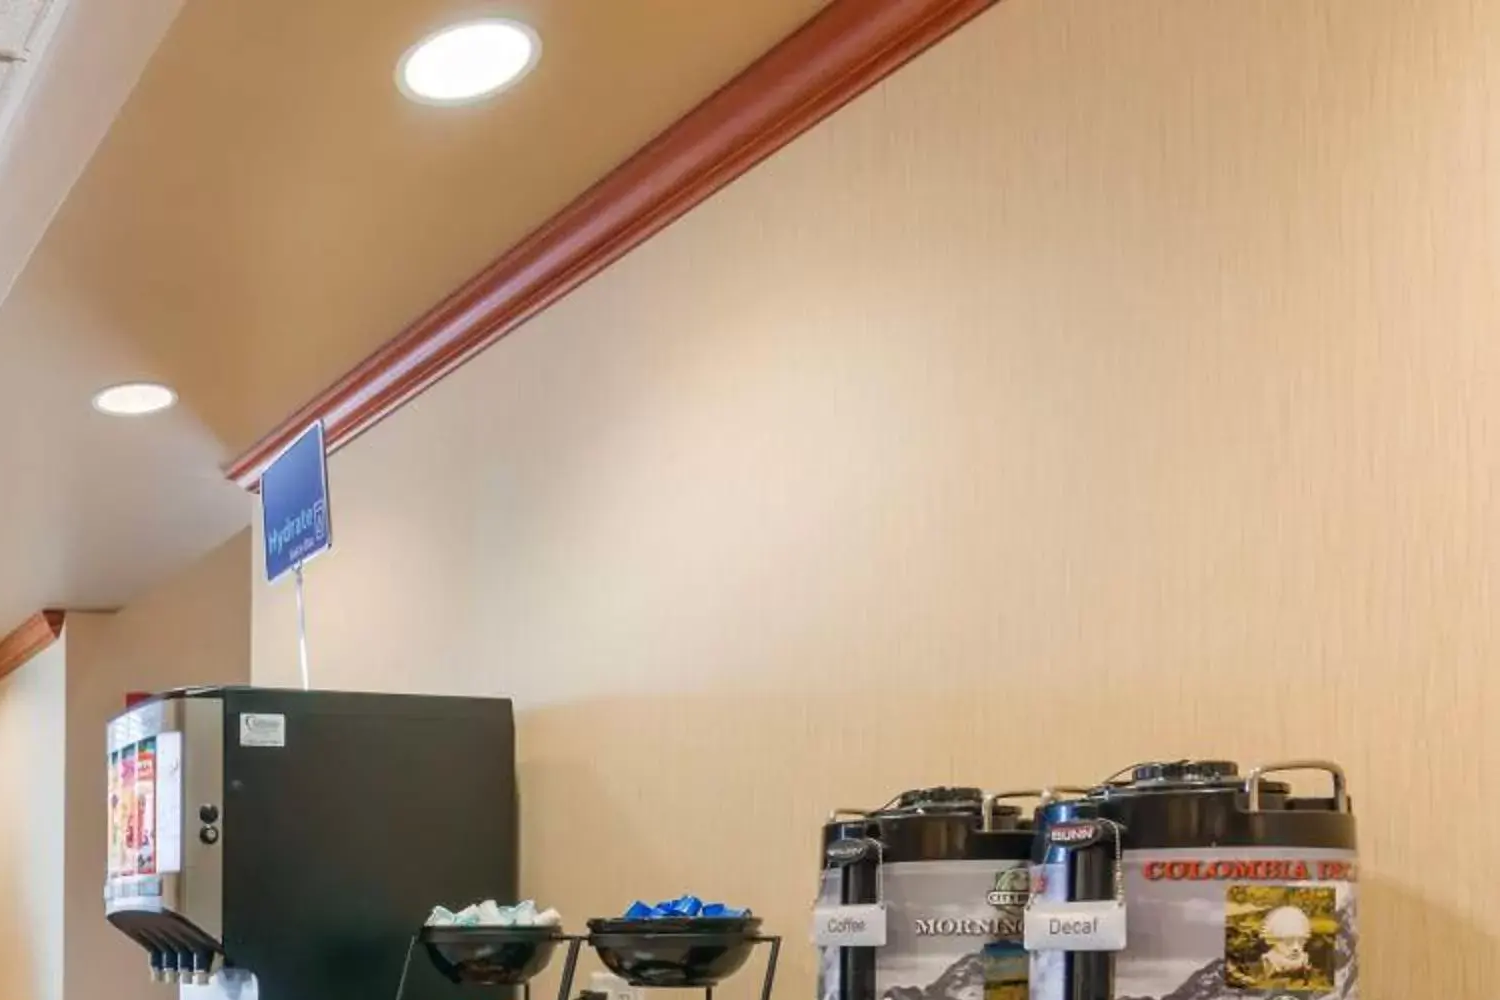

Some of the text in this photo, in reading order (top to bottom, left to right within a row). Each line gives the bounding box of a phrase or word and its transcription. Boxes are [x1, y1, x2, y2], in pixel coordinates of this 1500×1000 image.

[1051, 826, 1094, 841] BUNN
[1143, 860, 1309, 882] COLOMBIA
[826, 917, 867, 933] Coffee
[1049, 917, 1098, 935] Decaf
